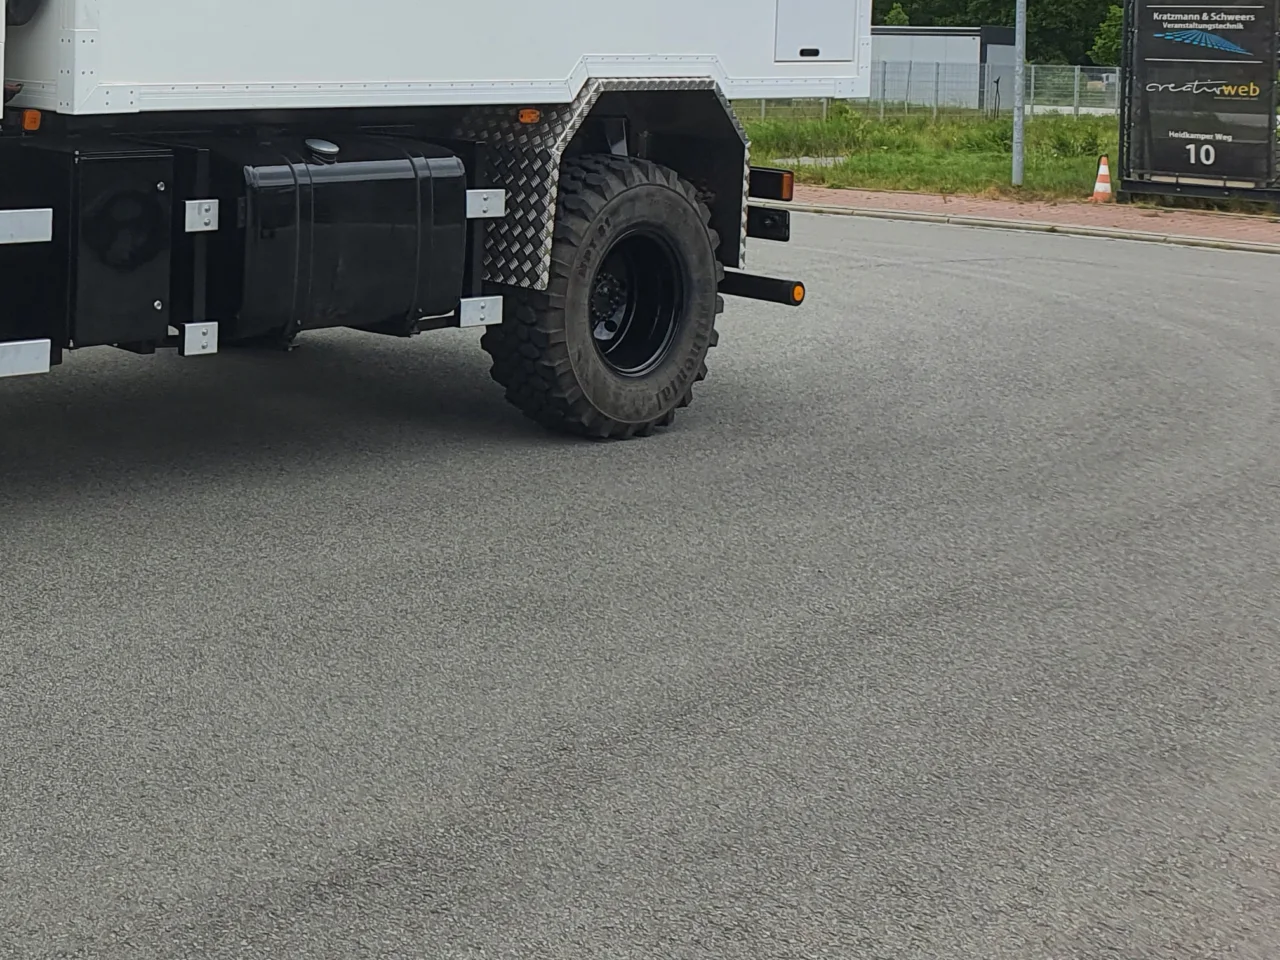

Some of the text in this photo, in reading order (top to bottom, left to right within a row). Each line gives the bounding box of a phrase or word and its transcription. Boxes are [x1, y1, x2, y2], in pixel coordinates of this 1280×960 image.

[1153, 12, 1256, 21] Kratzmann & Schweers
[1162, 22, 1244, 31] Veranstaltungstechnik
[1168, 130, 1233, 142] Heidkamper Weg
[1185, 143, 1216, 166] 10
